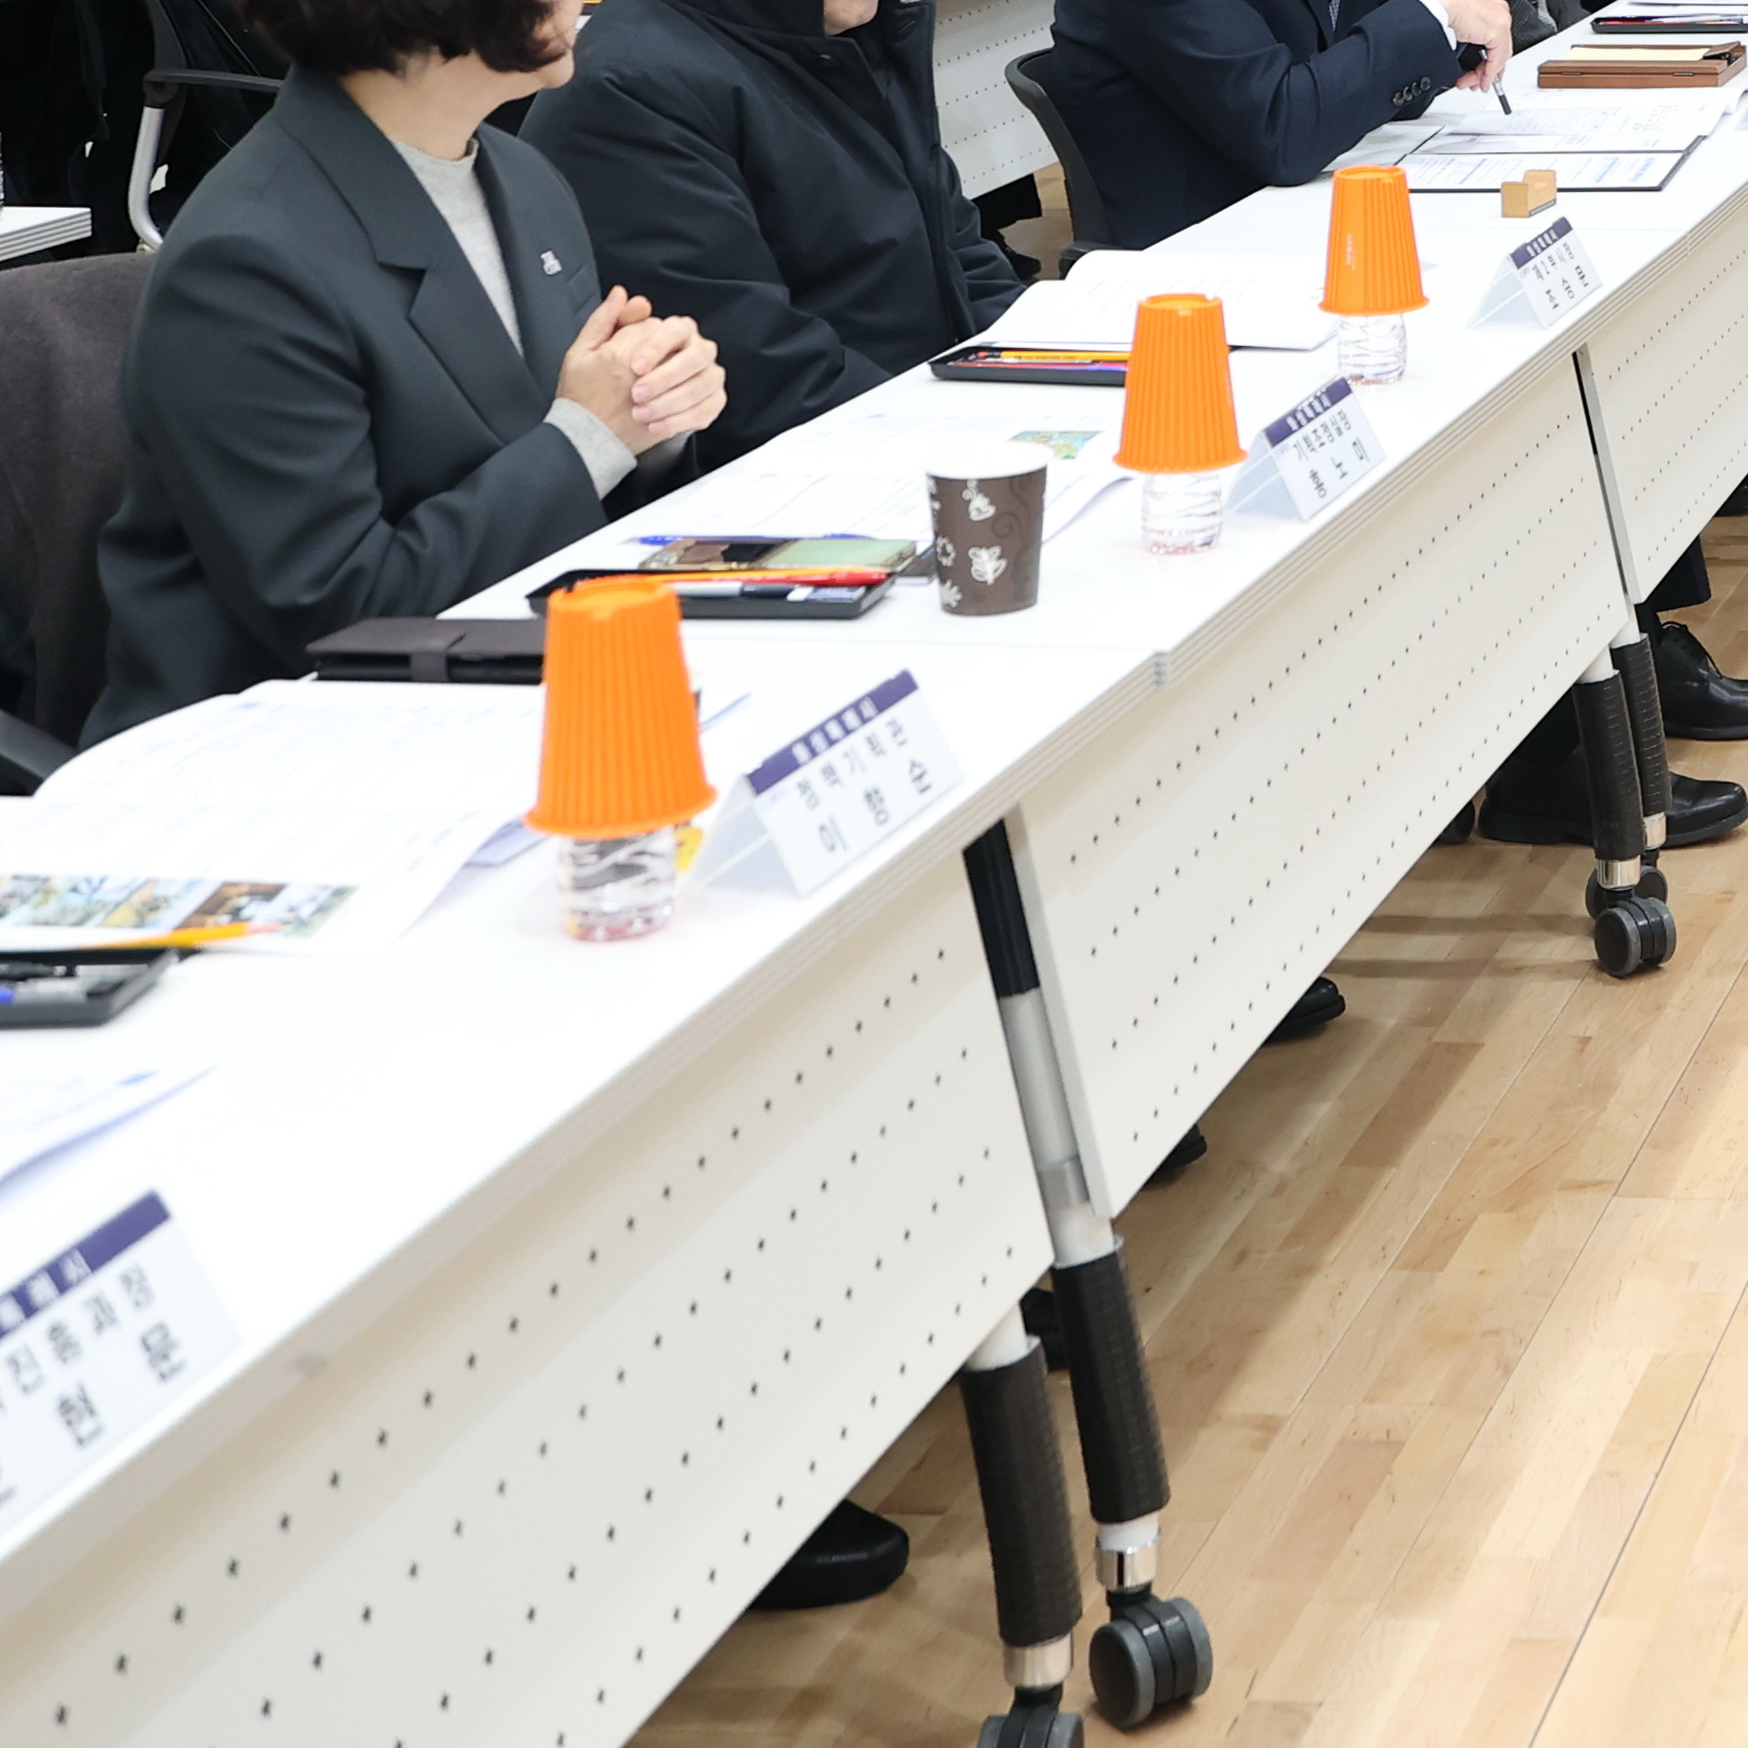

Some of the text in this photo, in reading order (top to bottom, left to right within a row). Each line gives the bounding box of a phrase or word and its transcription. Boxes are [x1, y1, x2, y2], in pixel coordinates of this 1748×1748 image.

[1532, 242, 1574, 281] 제2부시장
[1545, 265, 1590, 310] 조승문
[1292, 409, 1351, 461] 기획조정실장
[1308, 435, 1370, 499] 홍노미
[796, 717, 908, 810] 정책기획관
